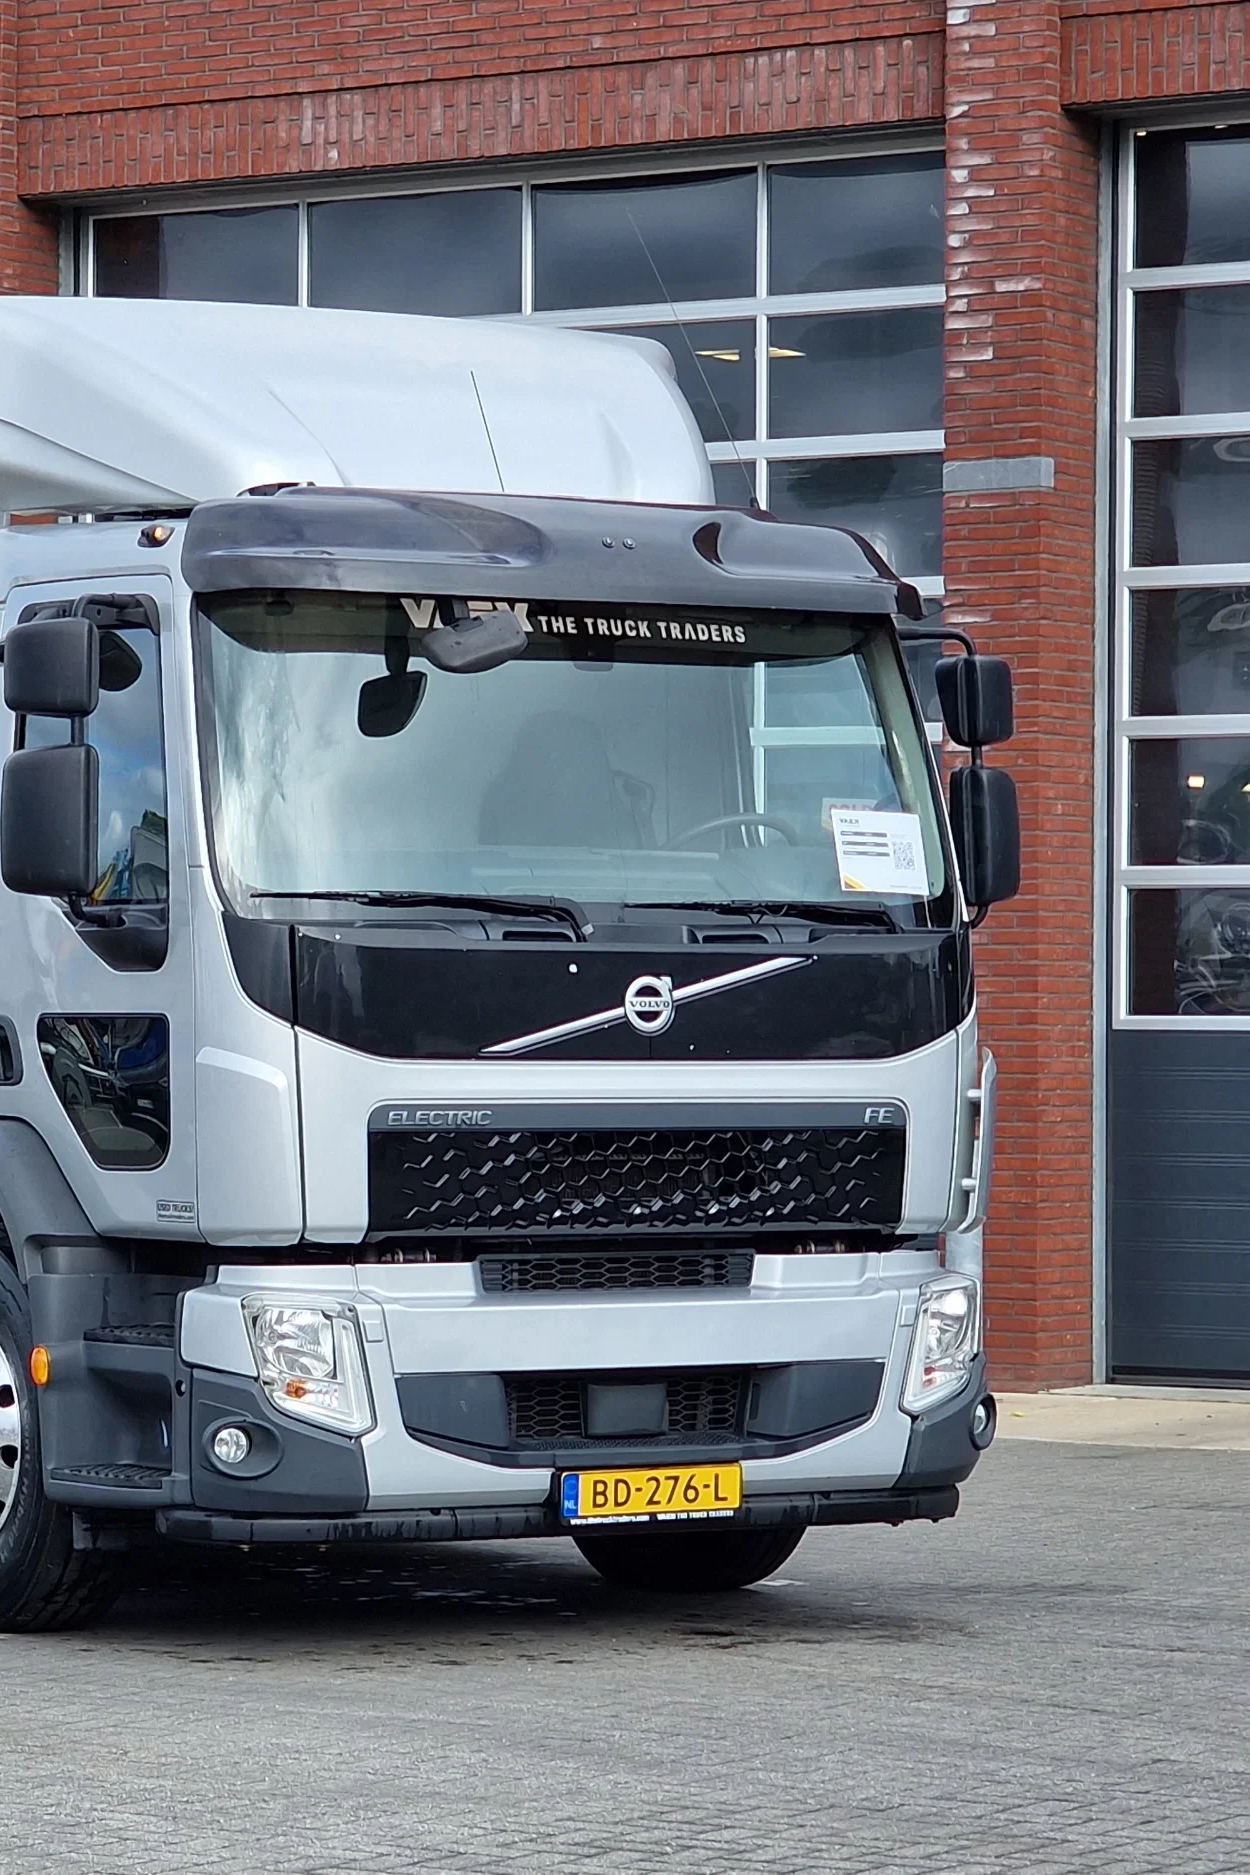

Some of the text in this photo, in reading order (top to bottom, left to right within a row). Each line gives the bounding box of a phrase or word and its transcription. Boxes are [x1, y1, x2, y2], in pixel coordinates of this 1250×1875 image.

[537, 615, 746, 644] THE TRUCK TRADERS
[629, 1000, 670, 1009] VOLVO
[387, 1110, 493, 1125] ELECTRIC
[863, 1107, 895, 1124] FE
[592, 1473, 729, 1509] BD-276-L
[564, 1500, 578, 1510] NL
